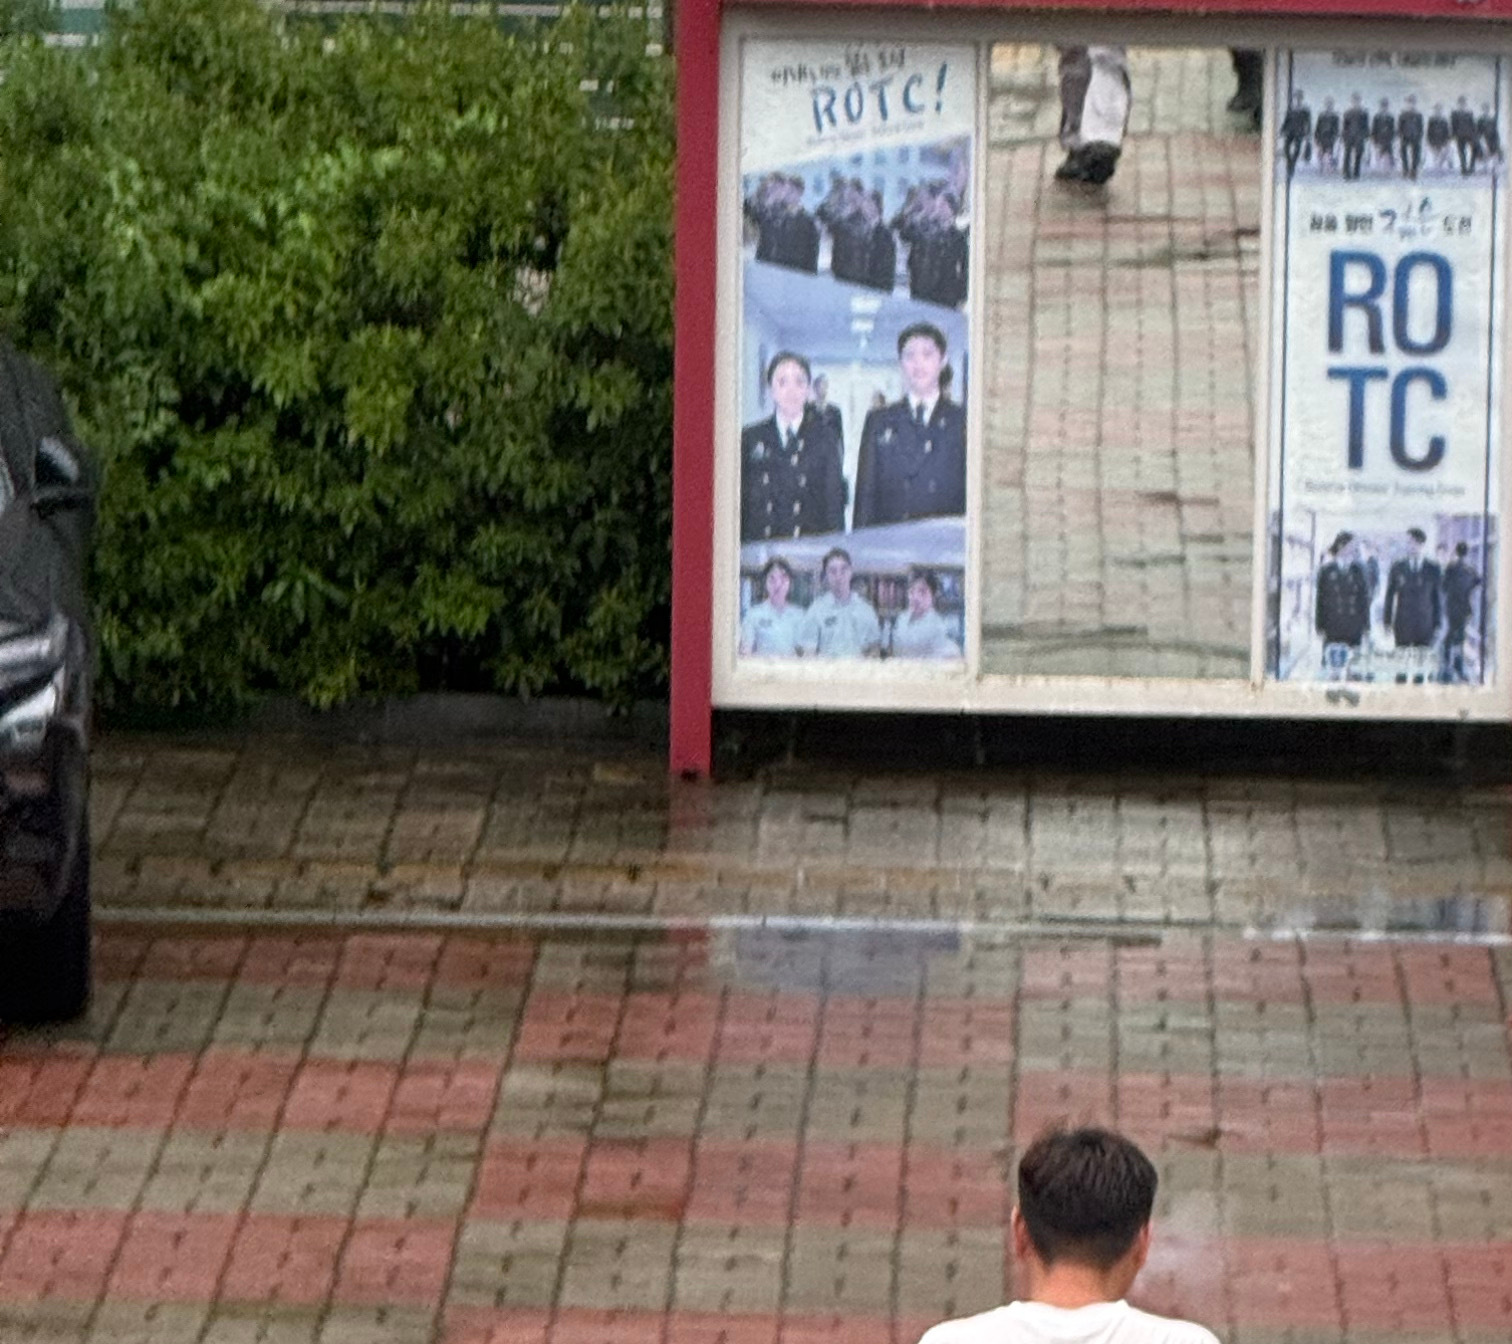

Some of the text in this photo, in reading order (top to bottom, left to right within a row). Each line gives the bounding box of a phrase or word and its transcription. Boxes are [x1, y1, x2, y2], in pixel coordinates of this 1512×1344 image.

[811, 60, 948, 133] ROTC!
[1327, 249, 1454, 356] RO
[1326, 365, 1448, 471] TC
